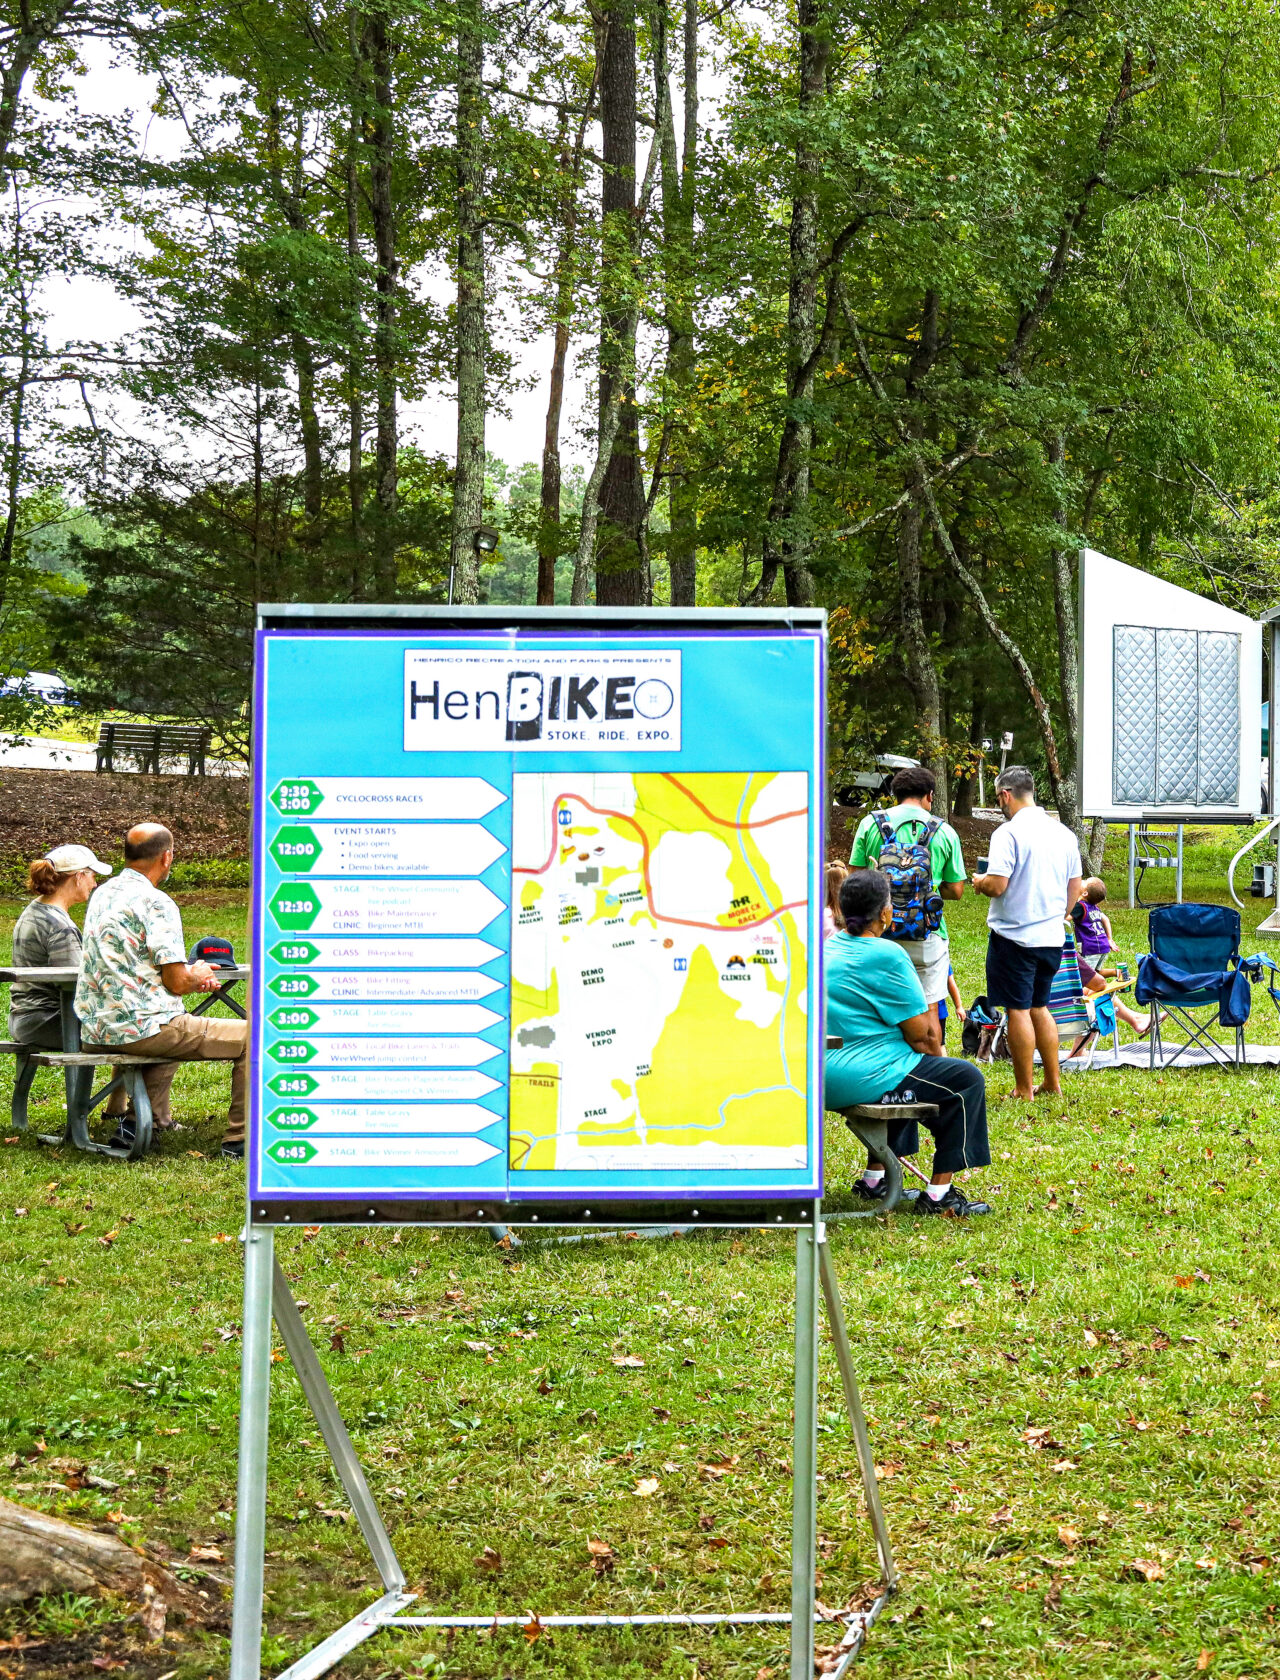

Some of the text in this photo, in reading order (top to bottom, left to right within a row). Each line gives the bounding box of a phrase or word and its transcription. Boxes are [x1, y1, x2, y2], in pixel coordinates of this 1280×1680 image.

[547, 731, 672, 741] STOKE. RIDE. EXPO.
[280, 786, 309, 797] 9:30
[280, 798, 310, 809] 3:00
[277, 843, 314, 856] 12:00
[278, 901, 313, 913] 12:30
[728, 907, 750, 919] MORE
[604, 918, 624, 926] CRAFTS
[737, 914, 757, 924] RACE
[281, 947, 308, 959] 1:30
[580, 967, 604, 978] DEMO
[280, 980, 308, 993] 2:30
[582, 976, 606, 986] BIKES
[279, 1012, 309, 1025] 3:00
[586, 1028, 617, 1040] VENDOR
[592, 1038, 612, 1048] EXPO
[279, 1045, 307, 1057] 3:30
[280, 1079, 307, 1091] 3:45
[529, 1079, 555, 1087] TRAILS
[277, 1112, 308, 1125] 4:00
[584, 1108, 607, 1117] STAGE
[277, 1146, 306, 1158] 4:45
